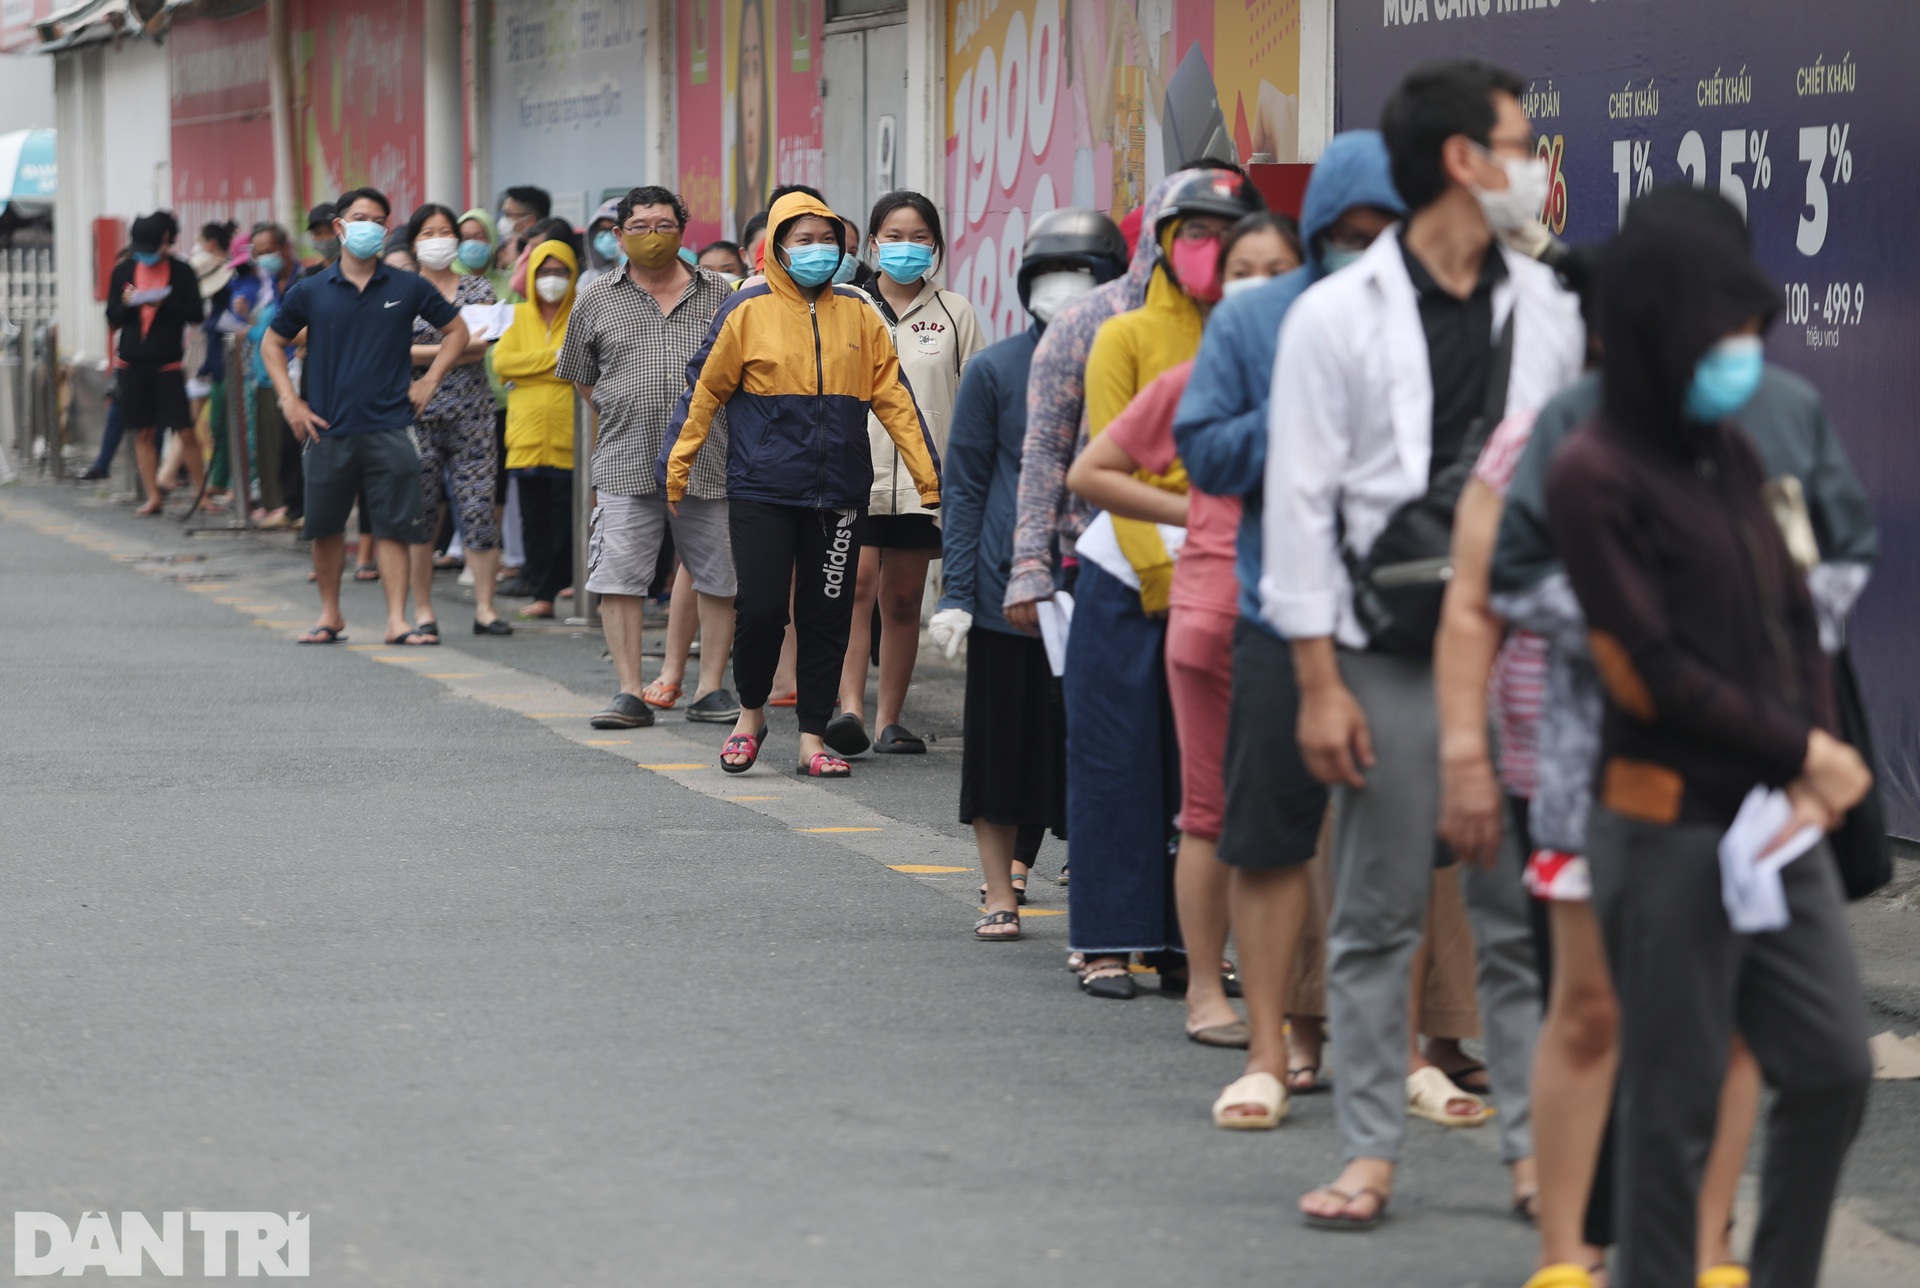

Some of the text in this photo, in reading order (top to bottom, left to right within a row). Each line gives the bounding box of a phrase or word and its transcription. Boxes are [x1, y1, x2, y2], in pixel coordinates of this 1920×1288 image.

[1383, 0, 1429, 27] MUA
[1697, 64, 1751, 108] CHIẾT KHẤU
[1797, 51, 1856, 96] CHIẾT KHẤU
[953, 0, 1060, 240] 1900
[1522, 79, 1560, 119] HẤP DẪN
[1608, 78, 1659, 119] CHIẾT KHẤU
[1612, 140, 1653, 236] 1%
[1676, 129, 1772, 228] 25%
[1796, 122, 1853, 256] 3%
[1785, 282, 1809, 326] 100
[1823, 282, 1864, 326] 499.9
[911, 321, 945, 333] 07.07
[1806, 326, 1823, 352] triệu
[822, 527, 852, 599] adidas
